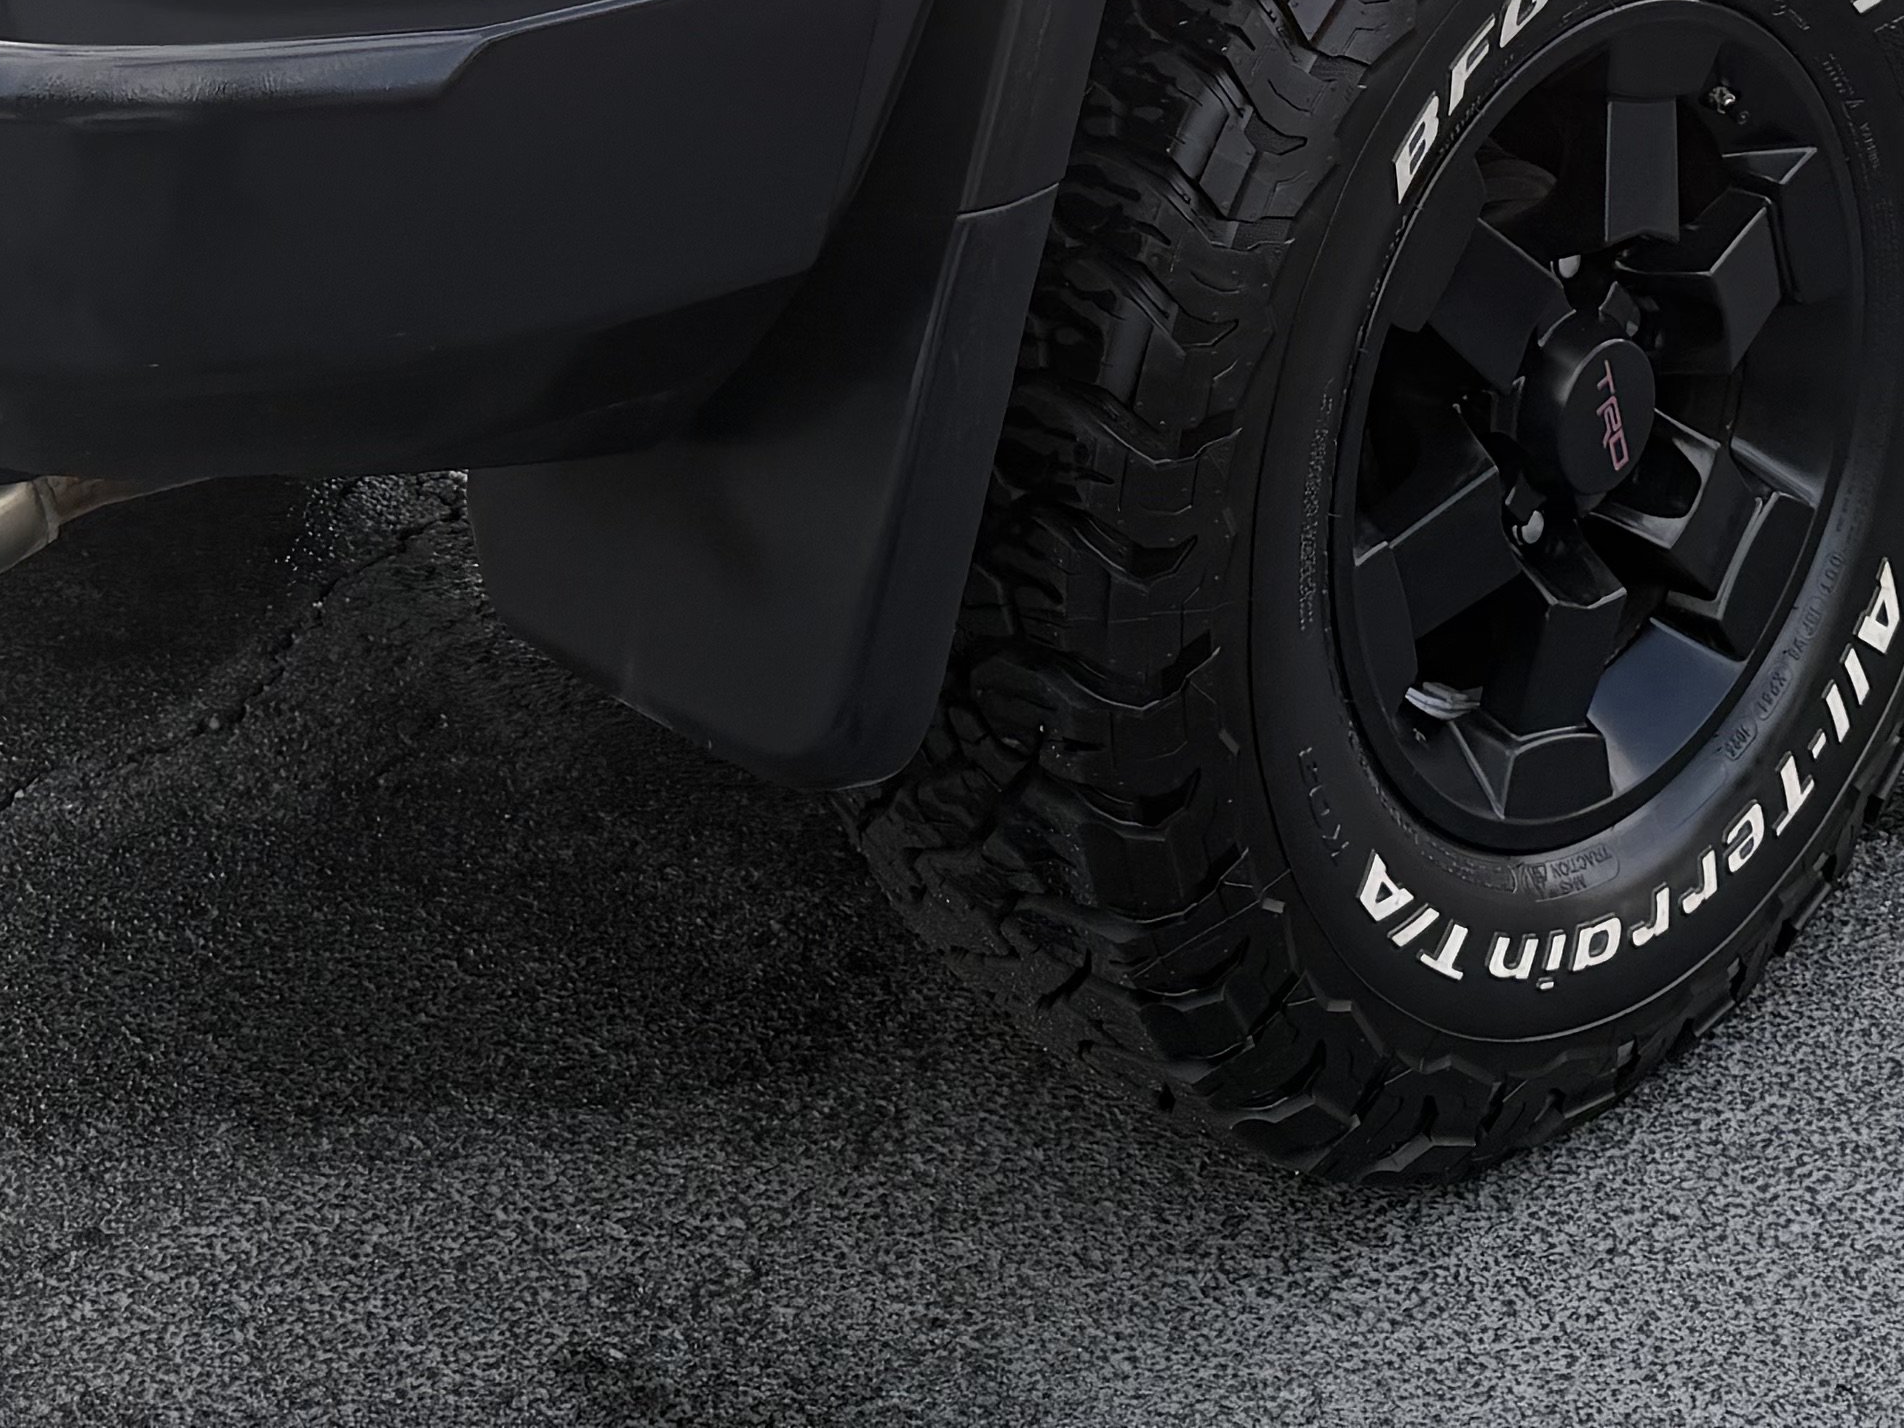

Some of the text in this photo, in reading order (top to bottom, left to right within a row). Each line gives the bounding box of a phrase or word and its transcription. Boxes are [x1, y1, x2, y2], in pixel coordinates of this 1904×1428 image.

[1596, 359, 1630, 471] TRD
[1356, 556, 1901, 991] All-Terrain T/A
